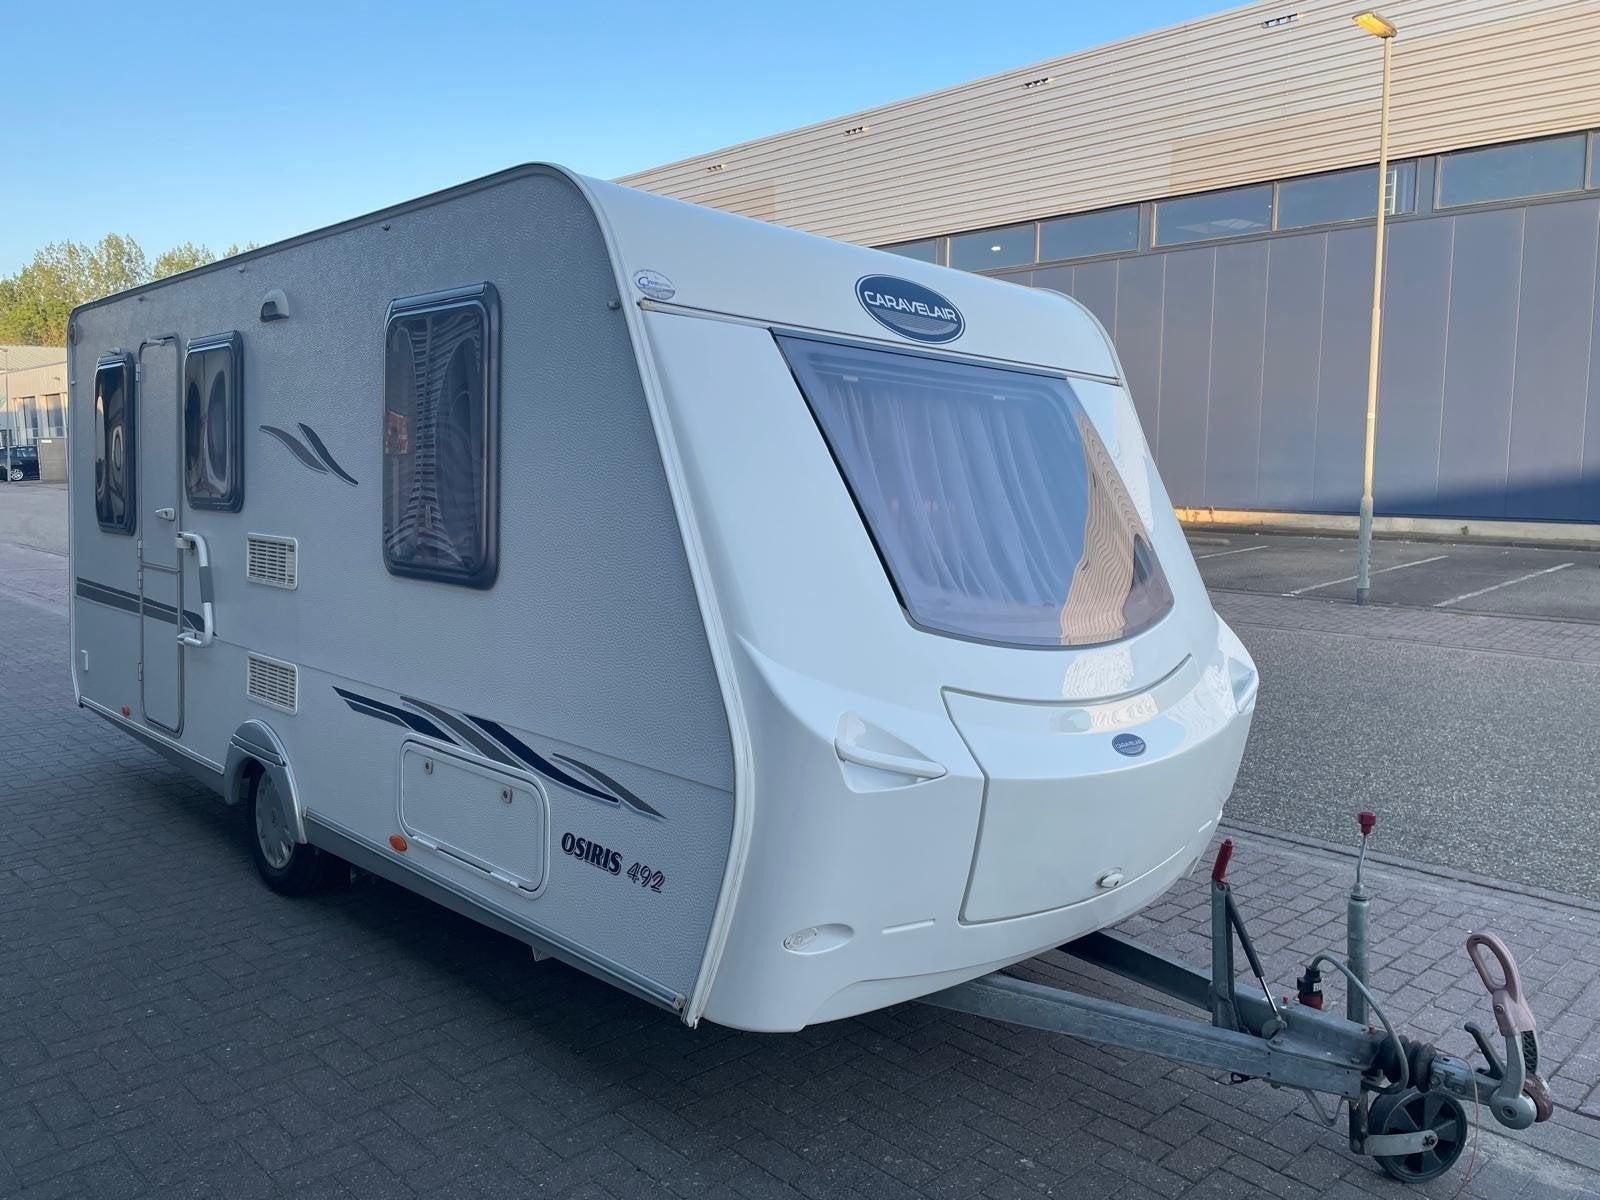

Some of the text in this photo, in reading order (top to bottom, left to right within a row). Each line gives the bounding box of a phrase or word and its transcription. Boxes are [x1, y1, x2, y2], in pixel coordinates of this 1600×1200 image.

[864, 291, 957, 321] CARAVELAIR
[561, 832, 665, 893] OSIRIS 492
